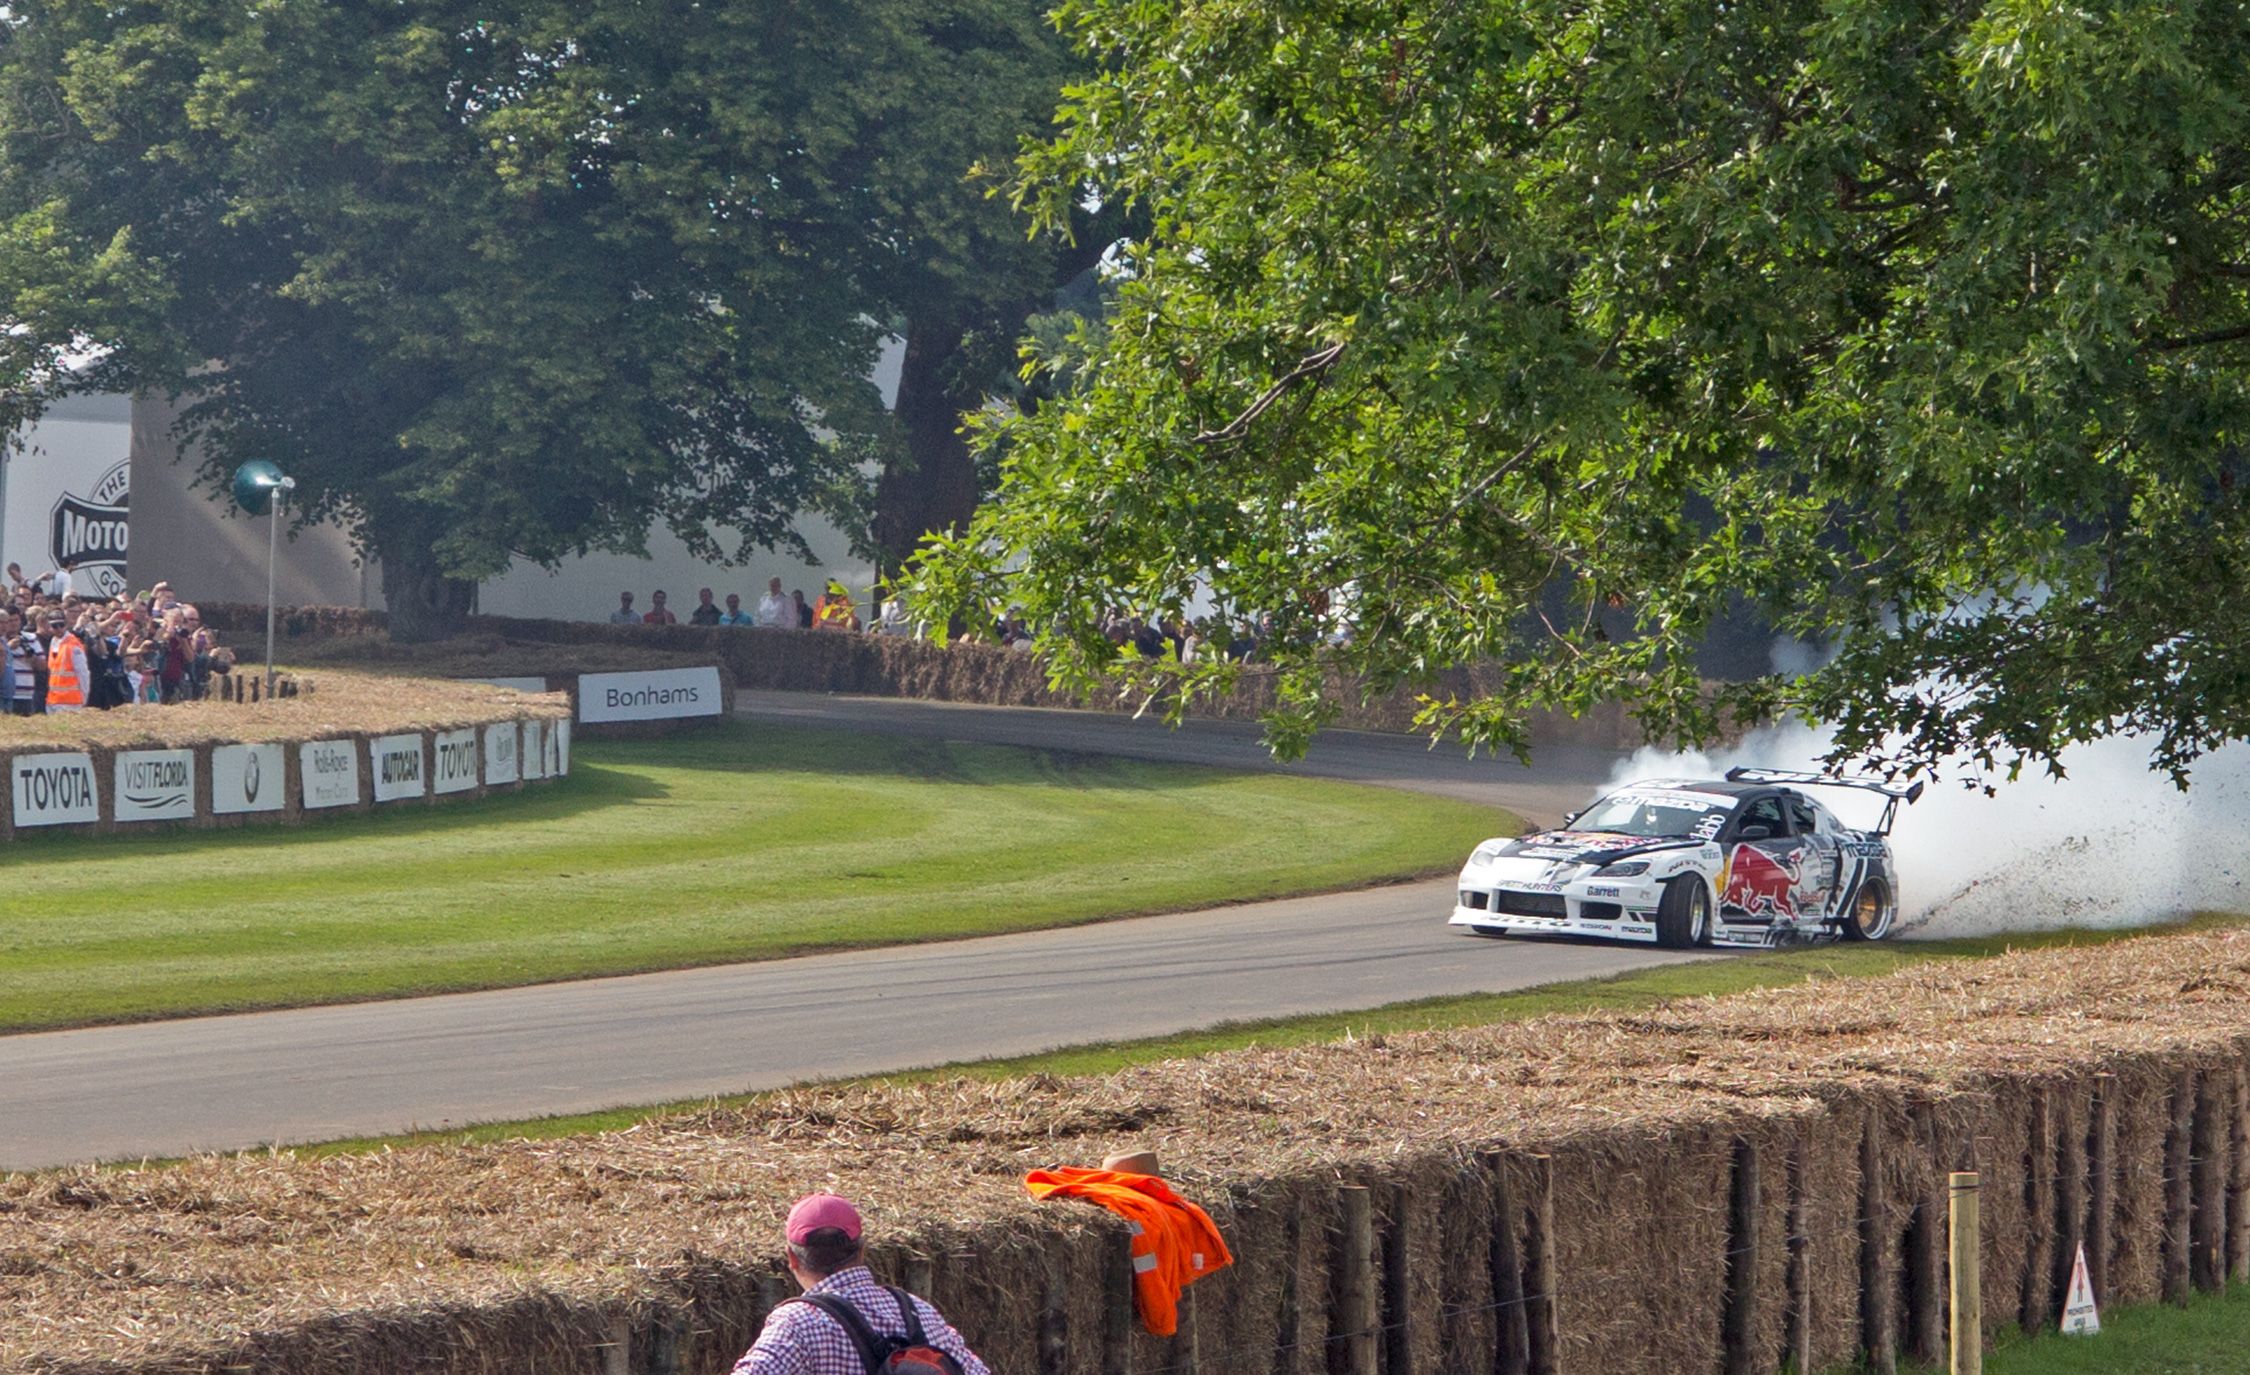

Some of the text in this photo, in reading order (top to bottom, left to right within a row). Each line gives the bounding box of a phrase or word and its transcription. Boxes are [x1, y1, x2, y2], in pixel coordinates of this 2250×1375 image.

[99, 470, 127, 503] THE
[62, 508, 128, 559] MOTO
[100, 570, 127, 597] GO
[606, 685, 699, 708] Bonhams
[381, 750, 420, 785] AUTOCAR
[20, 766, 92, 811] TOYOTA
[1586, 885, 1620, 898] Garrett
